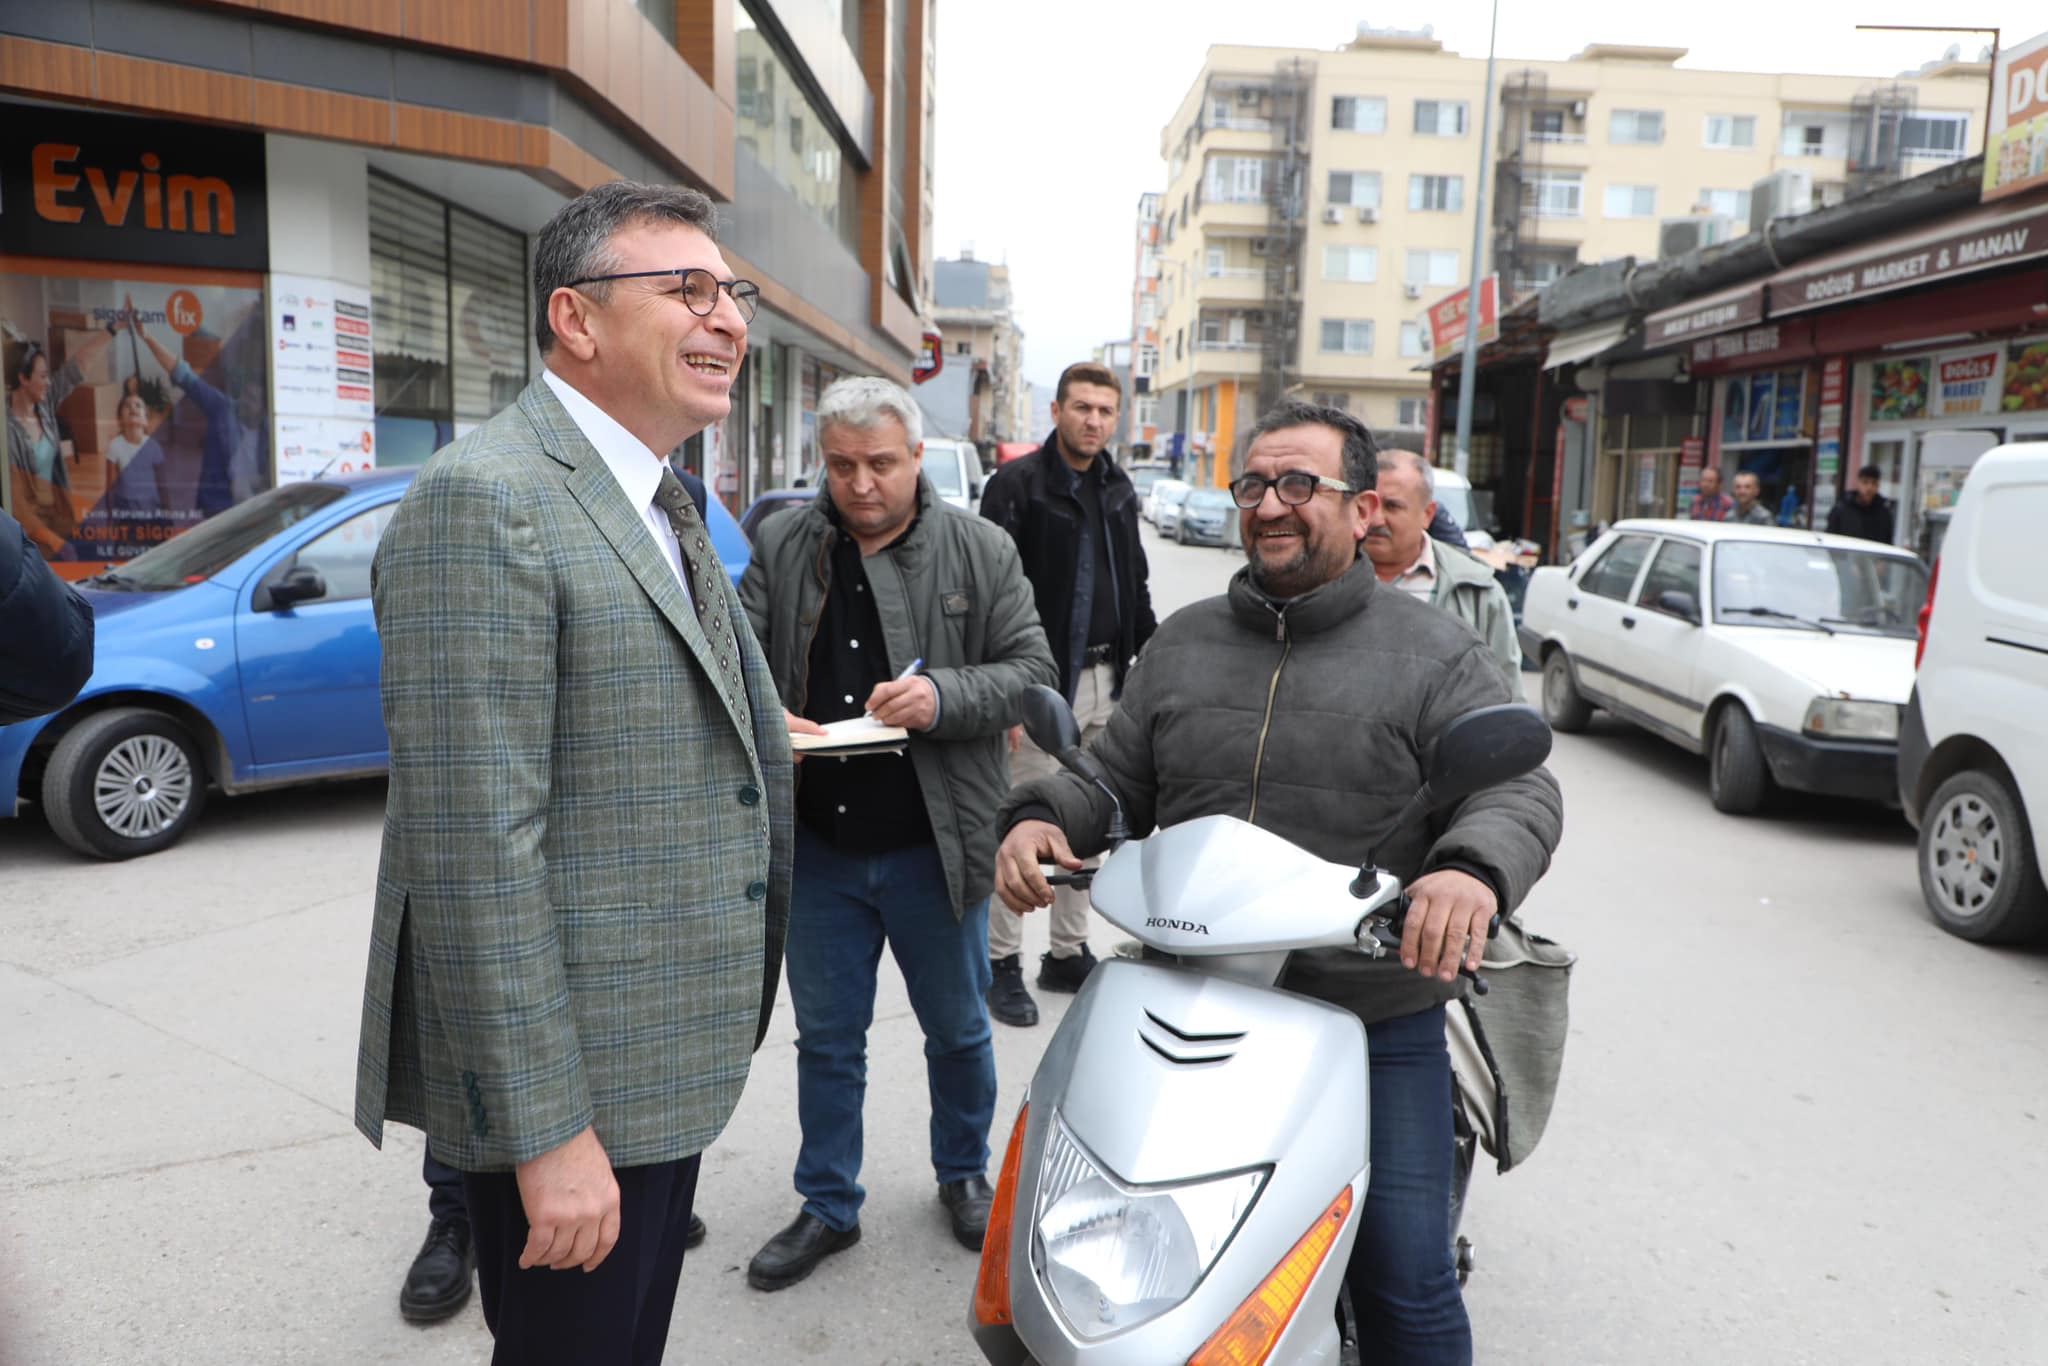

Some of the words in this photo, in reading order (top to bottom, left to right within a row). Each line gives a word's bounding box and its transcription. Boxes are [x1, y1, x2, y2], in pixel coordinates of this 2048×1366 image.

[32, 143, 236, 235] Evim
[1862, 254, 1931, 288] MARKET
[1936, 248, 1951, 270] &
[1957, 228, 2030, 264] MANAV
[72, 526, 129, 541] KONUT
[1145, 918, 1209, 935] HONDA
